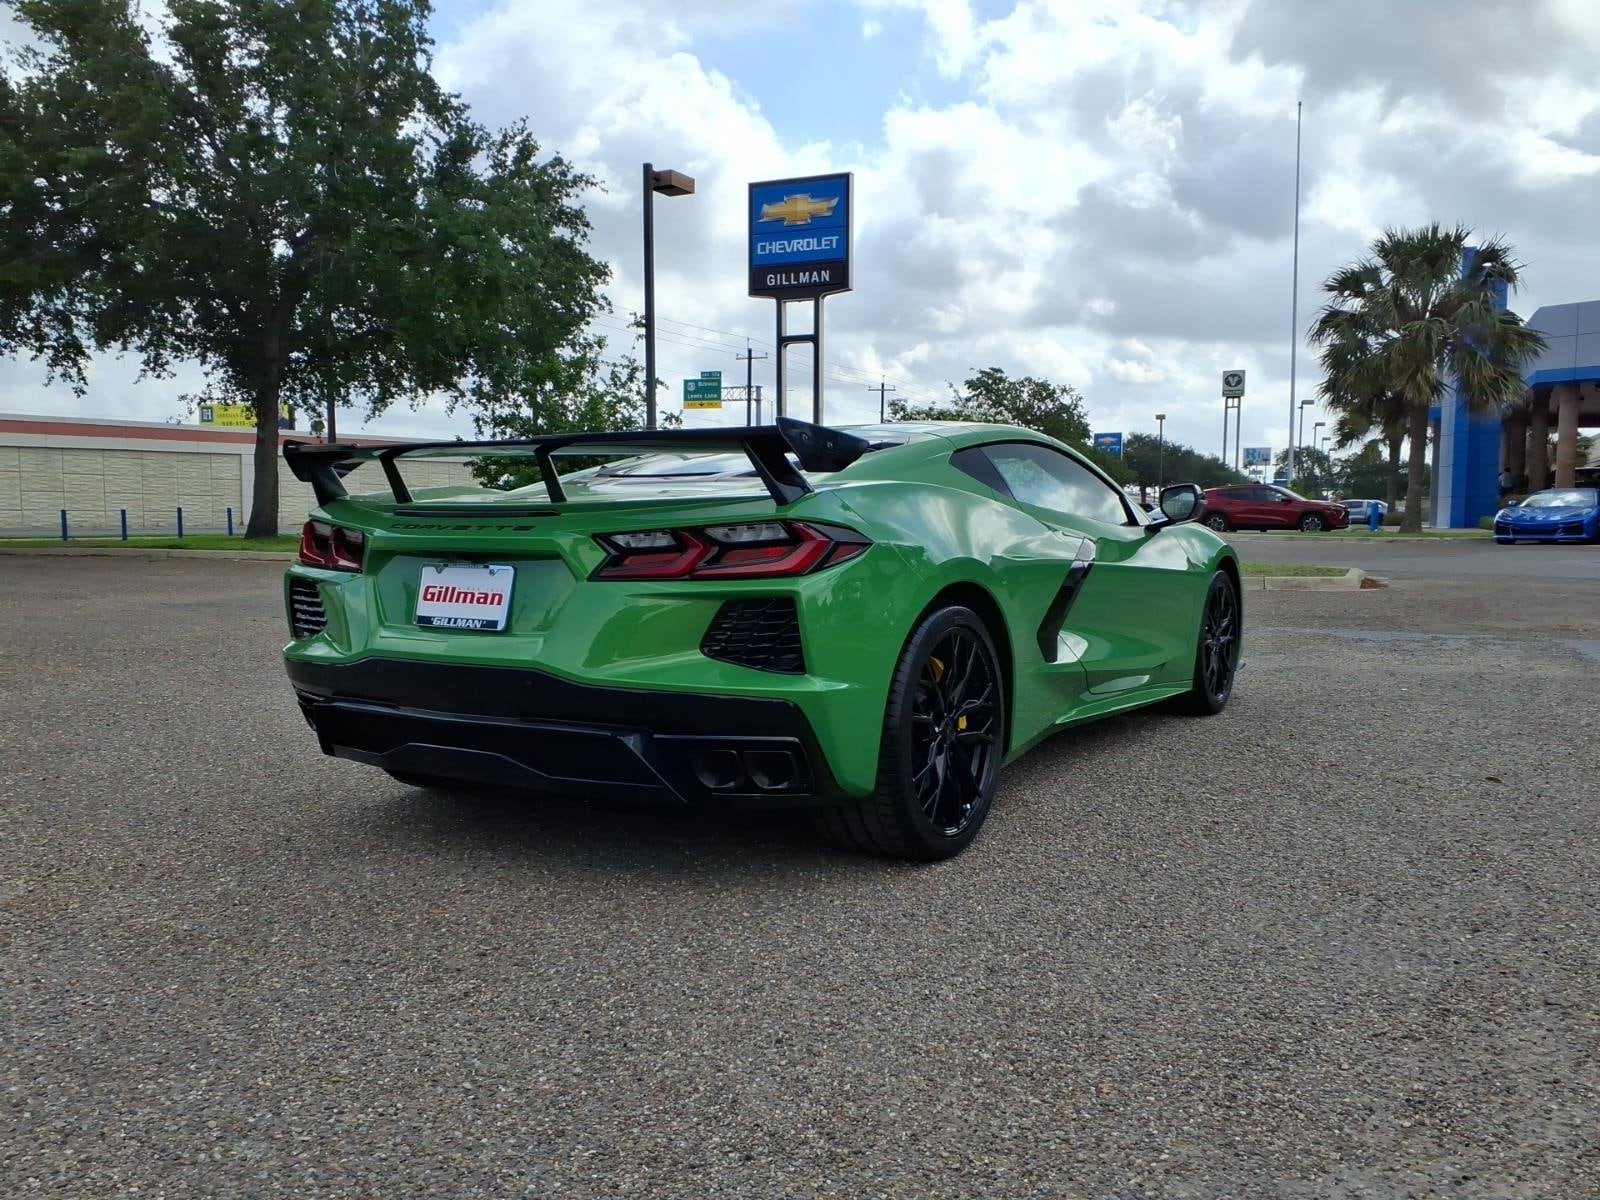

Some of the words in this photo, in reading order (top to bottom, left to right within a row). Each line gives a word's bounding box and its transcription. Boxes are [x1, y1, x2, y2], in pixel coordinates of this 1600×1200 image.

[757, 236, 839, 255] CHEVROLET
[766, 270, 830, 286] GILLMAN
[389, 523, 537, 532] CORVETTE
[422, 585, 504, 606] Gillman
